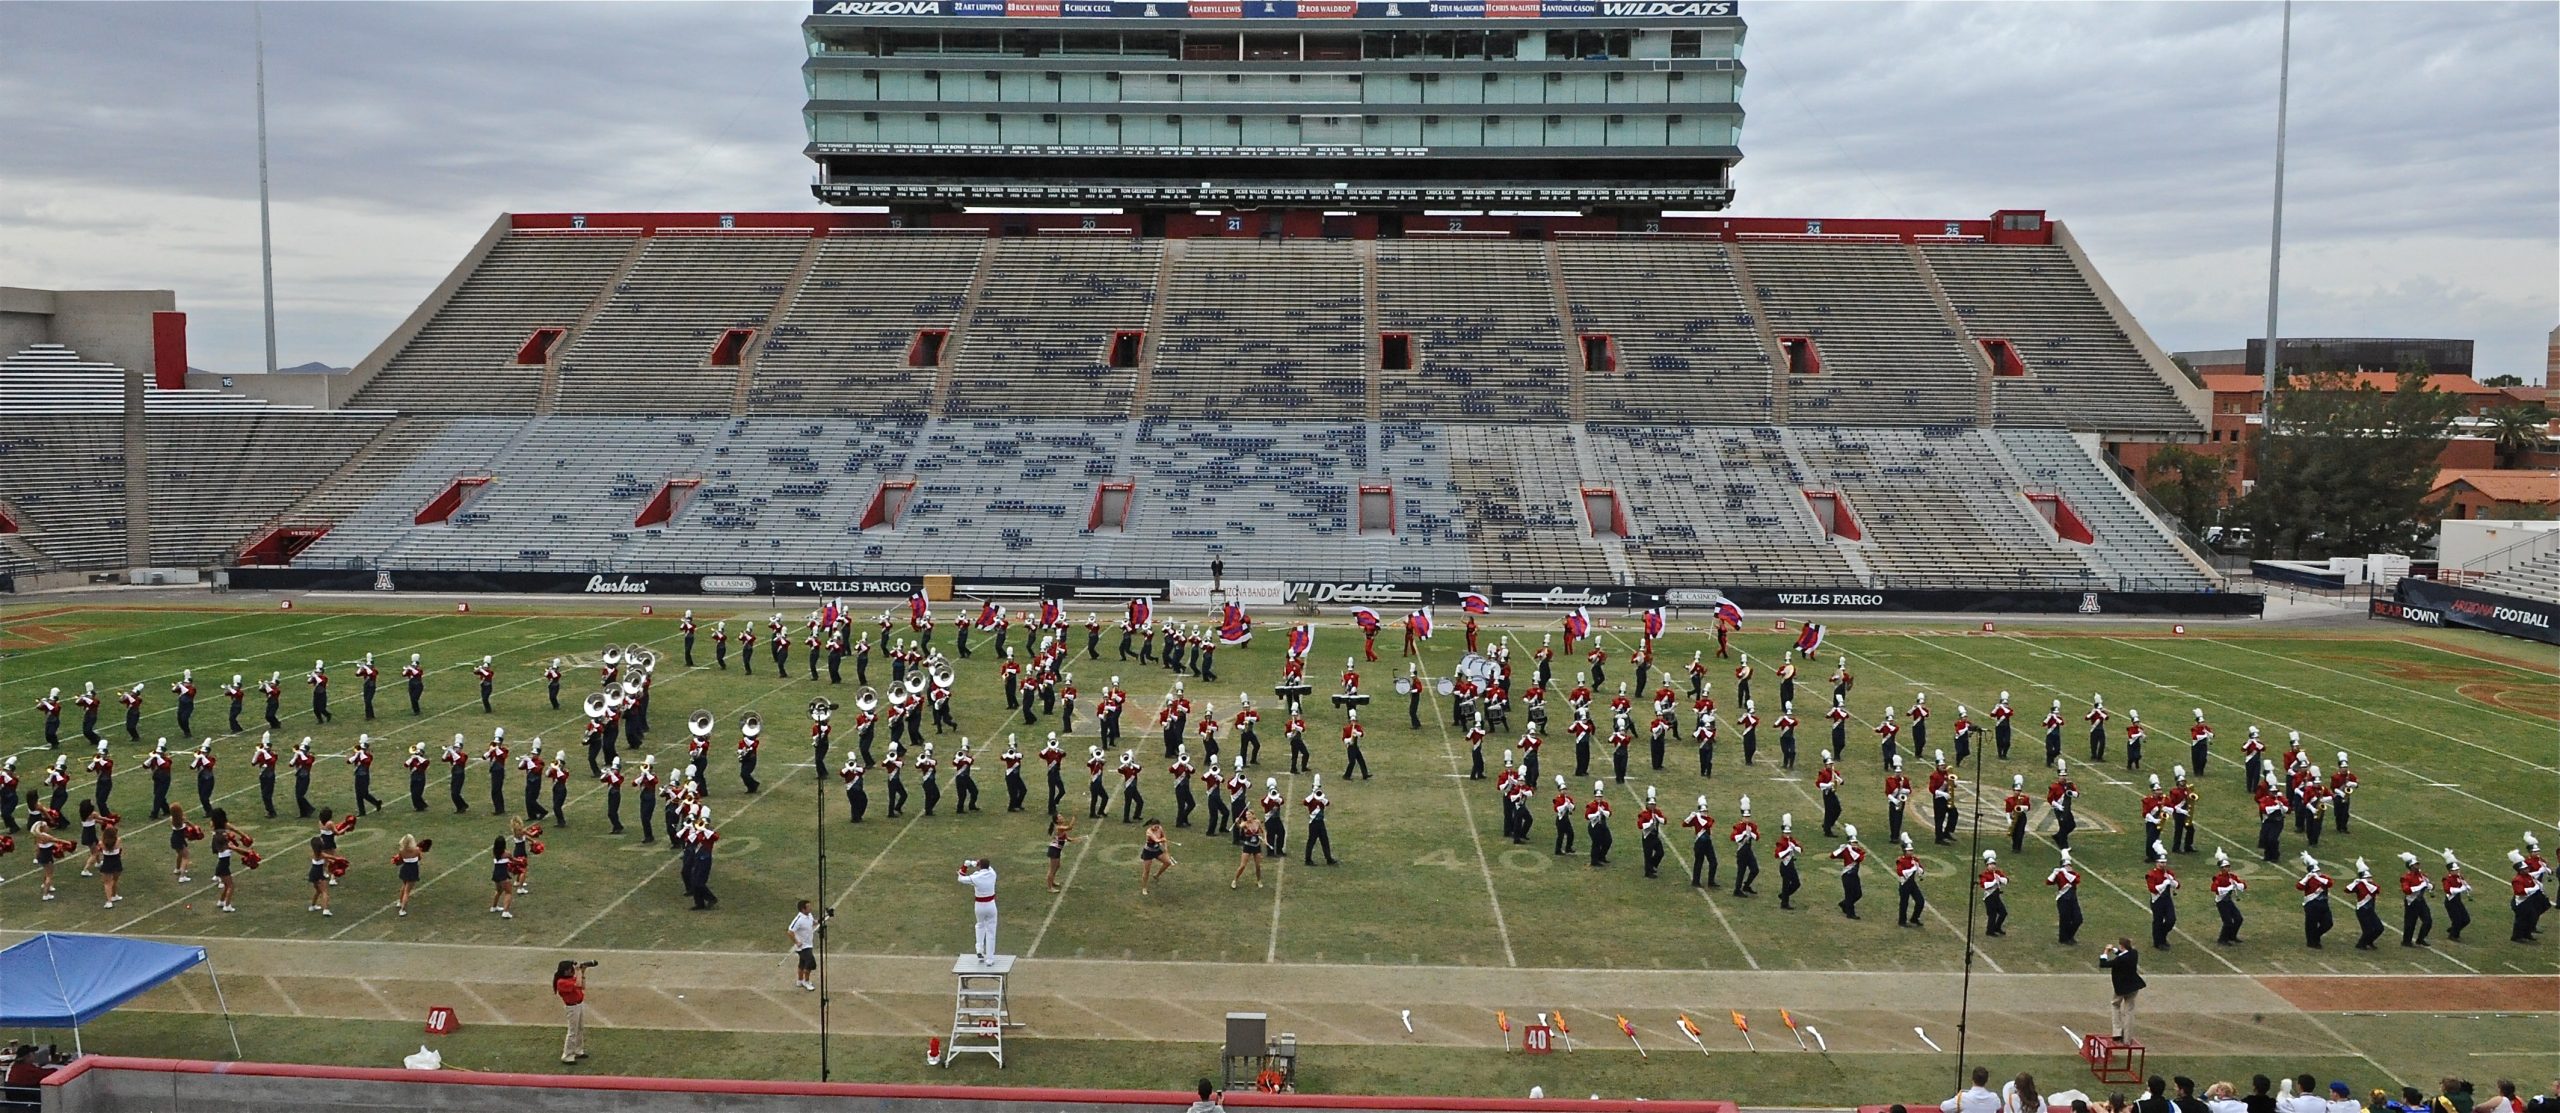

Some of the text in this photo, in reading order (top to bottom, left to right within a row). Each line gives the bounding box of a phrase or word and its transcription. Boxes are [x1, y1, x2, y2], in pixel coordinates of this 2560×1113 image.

[825, 2, 940, 14] ARIZONA
[954, 3, 962, 11] 22
[1035, 4, 1060, 12] HUNLEY
[1188, 5, 1242, 13] 4 DARRYLL LEWIS
[1306, 5, 1320, 13] ROB
[1320, 5, 1351, 13] WALDROP
[1491, 4, 1509, 12] CHRIS
[1509, 4, 1541, 12] McALISTER
[1546, 4, 1572, 12] ANTOINE
[1572, 4, 1595, 13] CASON
[1603, 2, 1731, 16] WILDCATS
[574, 220, 584, 229] 17
[721, 219, 733, 229] 18
[890, 220, 902, 229] 19
[1082, 220, 1096, 229] 20
[1228, 221, 1240, 230] 21
[1449, 223, 1462, 232] 22
[1646, 224, 1659, 233] 23
[1807, 226, 1821, 235] 24
[1945, 227, 1960, 236] 25
[223, 378, 233, 387] 16
[374, 570, 395, 591] A
[585, 574, 649, 593] Bashas'
[809, 581, 911, 593] WELLS FARGO
[1172, 587, 1206, 597] UNIVERSITY
[1248, 587, 1267, 598] BAND
[1267, 588, 1281, 598] DAY
[1777, 593, 1883, 605] WELLS FARGO
[2079, 592, 2101, 613] A
[2374, 601, 2439, 624] BEAR DOWN
[2451, 600, 2550, 628] ARIZONA FOOTBALL
[1413, 848, 1552, 874] 40
[428, 1010, 447, 1031] 40
[980, 1020, 994, 1036] 50
[1528, 1029, 1547, 1049] 40
